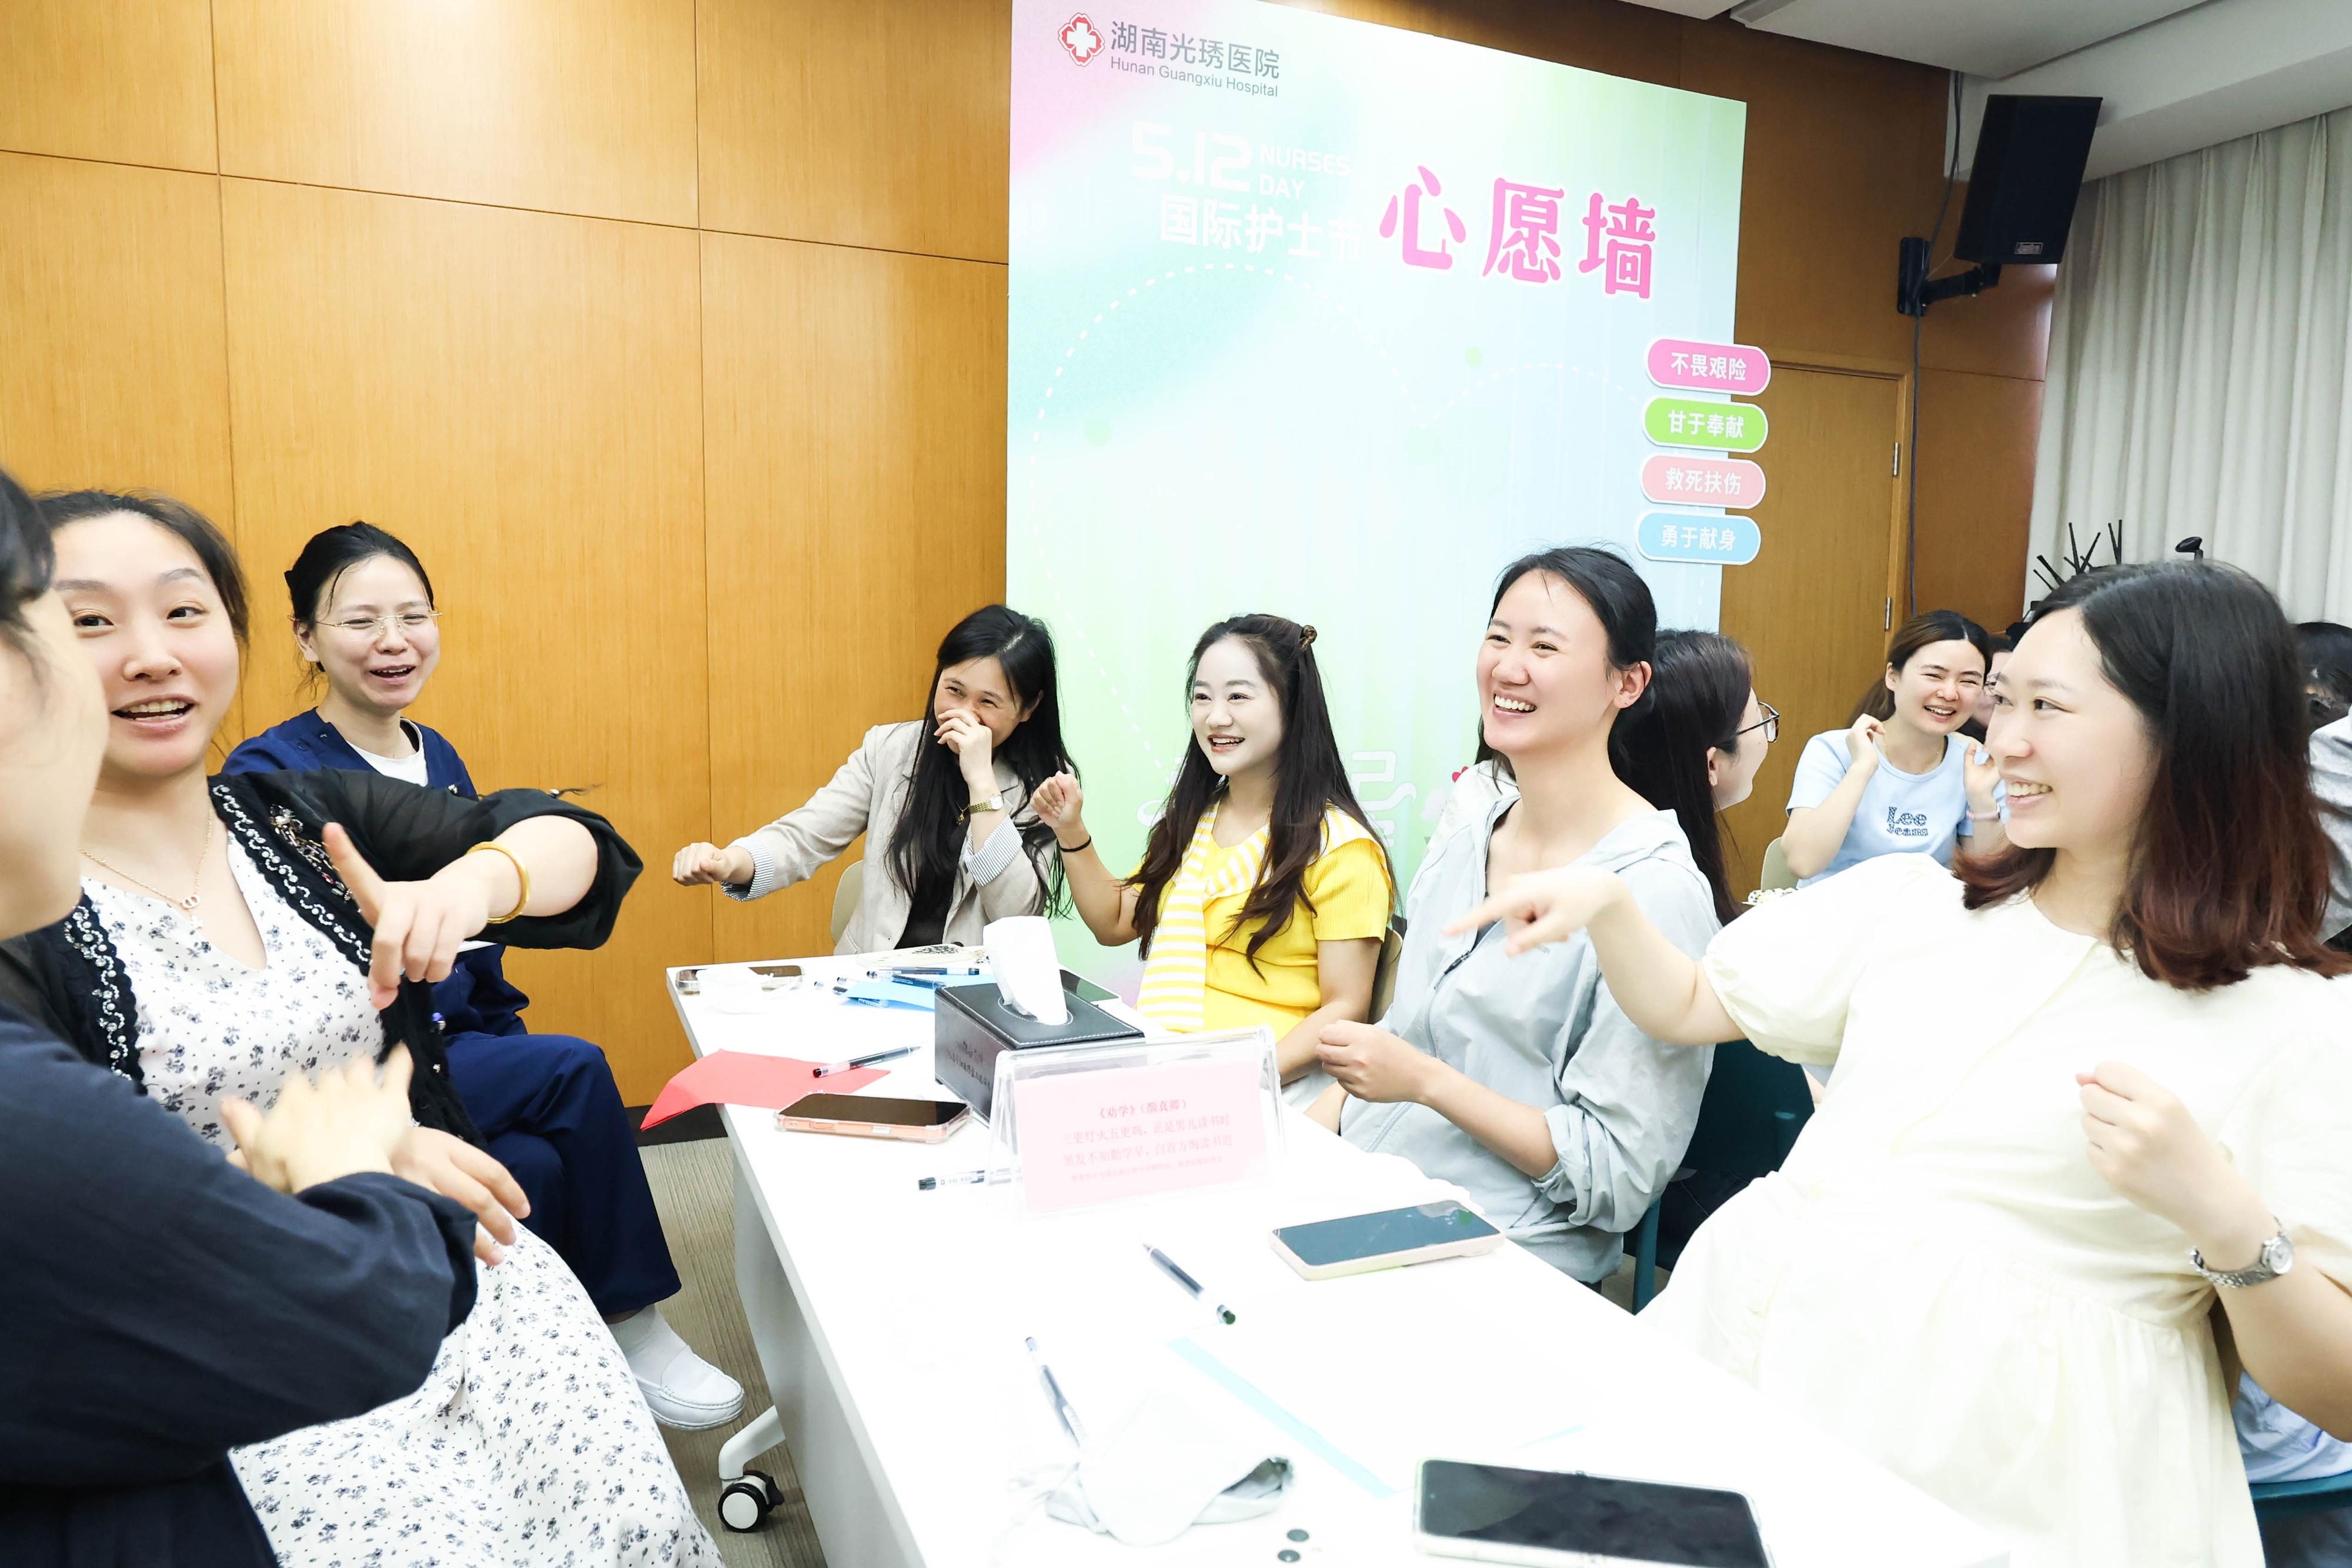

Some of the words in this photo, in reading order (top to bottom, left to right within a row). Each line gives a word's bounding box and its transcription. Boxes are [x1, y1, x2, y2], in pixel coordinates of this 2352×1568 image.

[1111, 21, 1279, 79] 湖南光琇医院
[1111, 56, 1154, 76] Hunan
[1159, 65, 1222, 86] Guangxiu
[1227, 77, 1278, 97] Hospital
[1131, 121, 1252, 192] 5.12
[1259, 142, 1351, 176] NURSES
[1259, 174, 1305, 199] DAY
[1161, 194, 1363, 263] 国际护士节
[1379, 165, 1656, 299] 心愿墙
[1671, 352, 1746, 381] 不畏艰险
[1668, 410, 1744, 439] 甘于奉献
[1665, 467, 1742, 495] 救死扶伤
[1661, 524, 1736, 551] 勇于献身
[1886, 806, 1927, 826] Lee
[1886, 824, 1929, 837] Jeans
